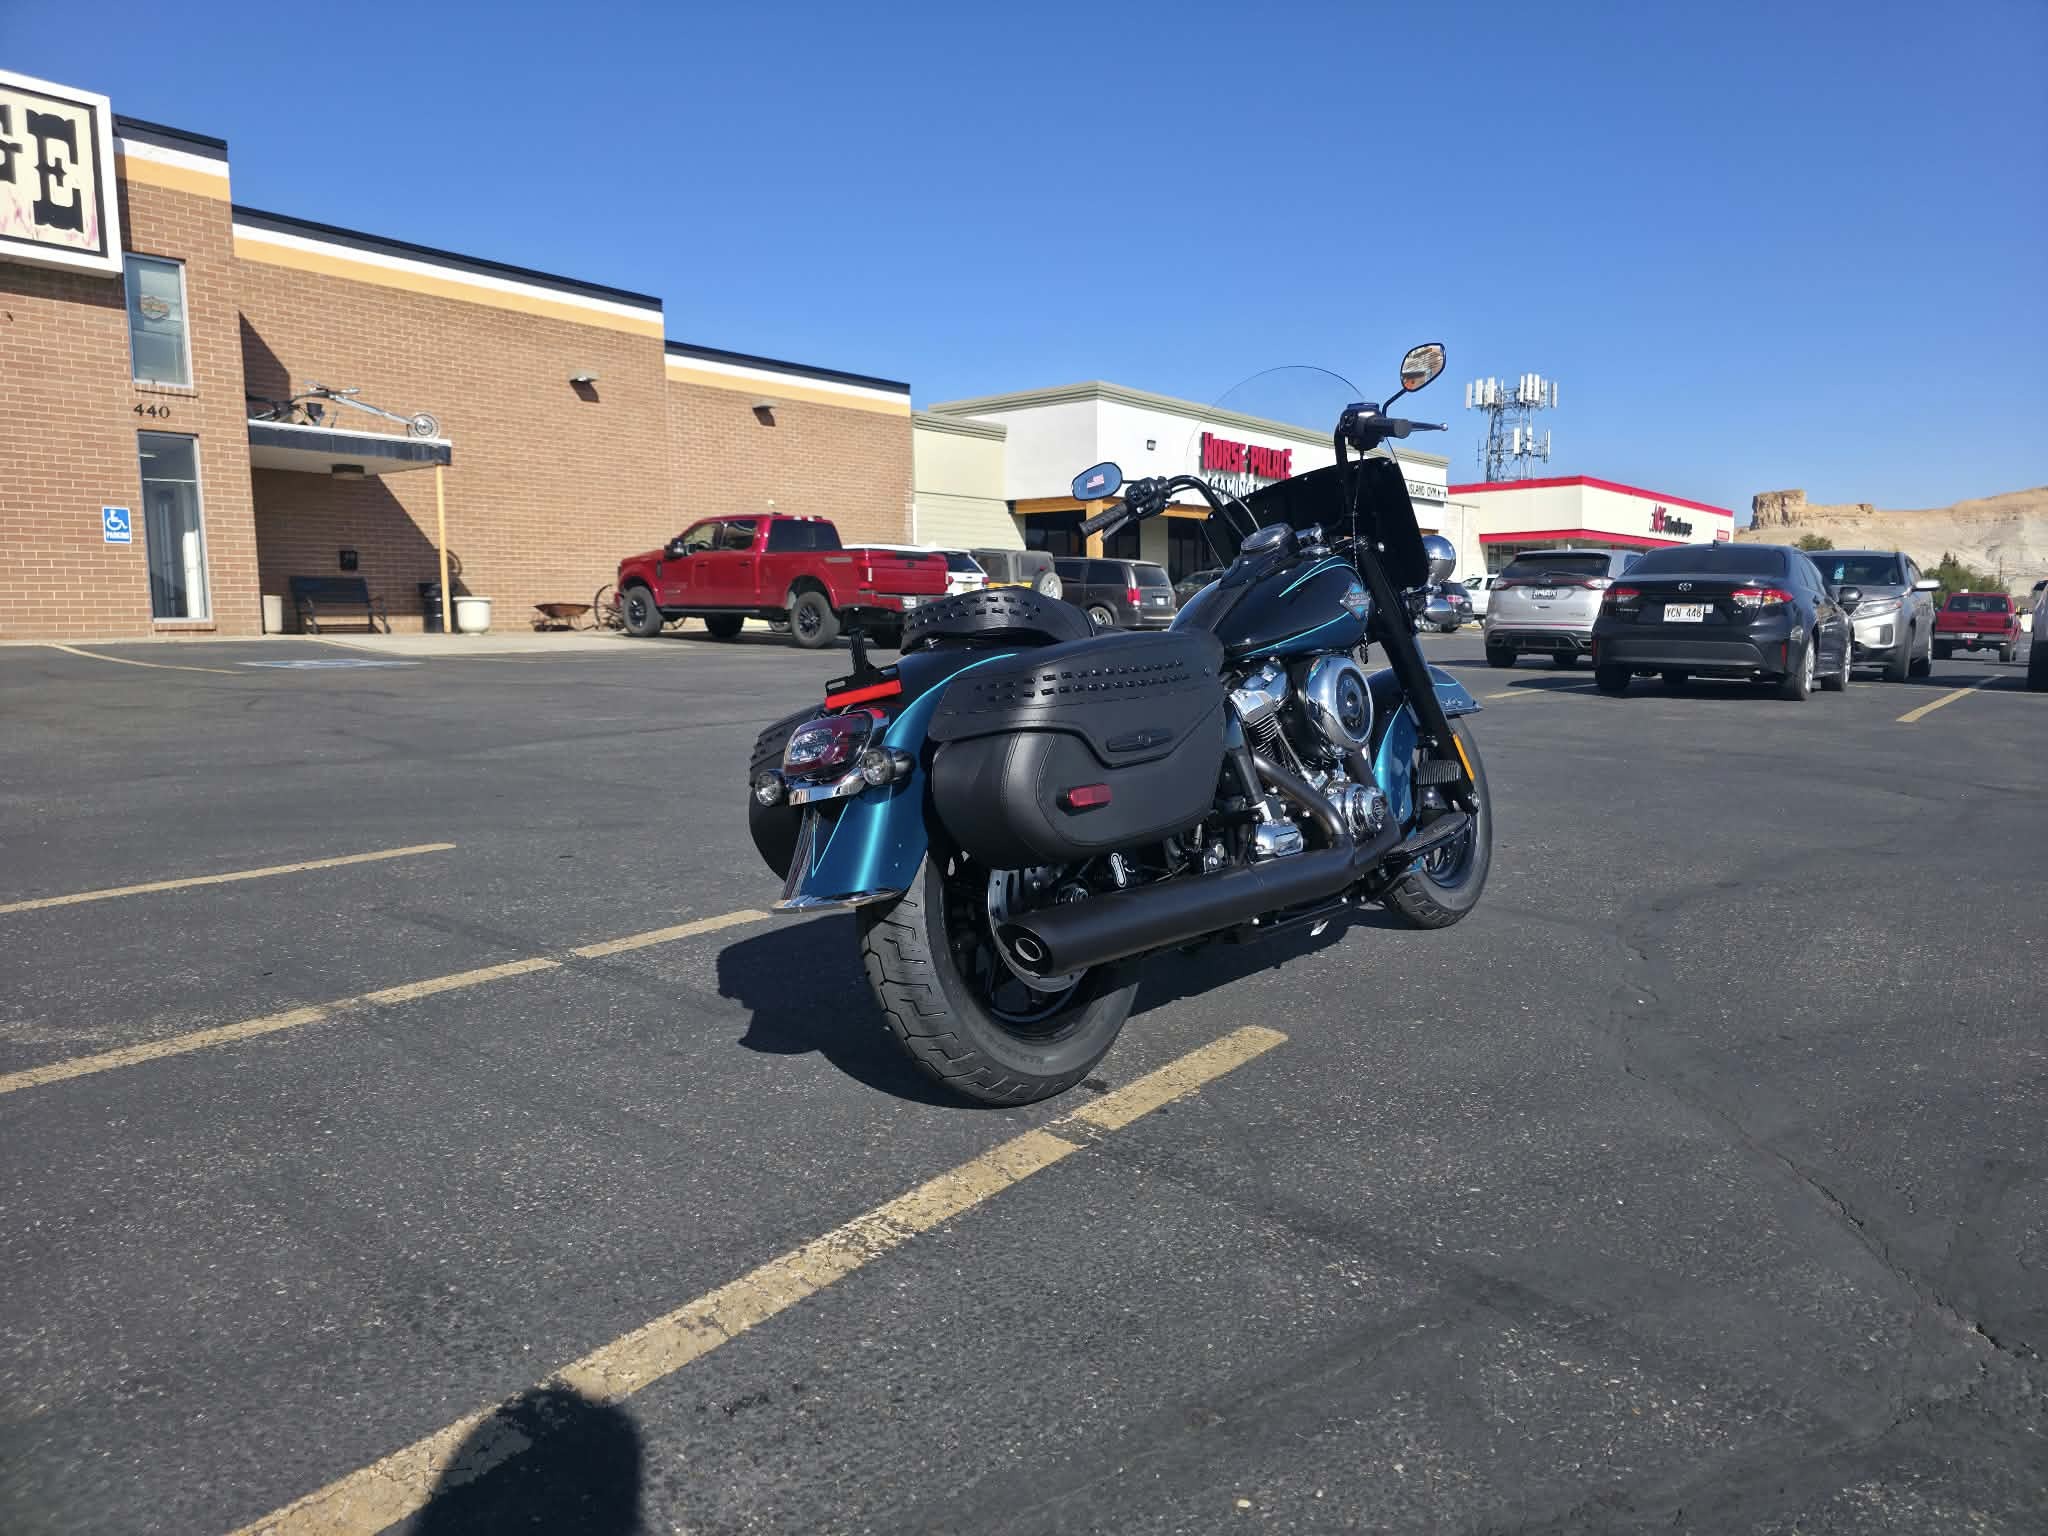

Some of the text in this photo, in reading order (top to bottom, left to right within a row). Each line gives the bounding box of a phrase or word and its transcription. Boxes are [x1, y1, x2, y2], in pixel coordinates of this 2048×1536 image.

[133, 403, 171, 419] 440
[1201, 431, 1292, 480] HORSE PALACE
[1666, 607, 1682, 618] YCN
